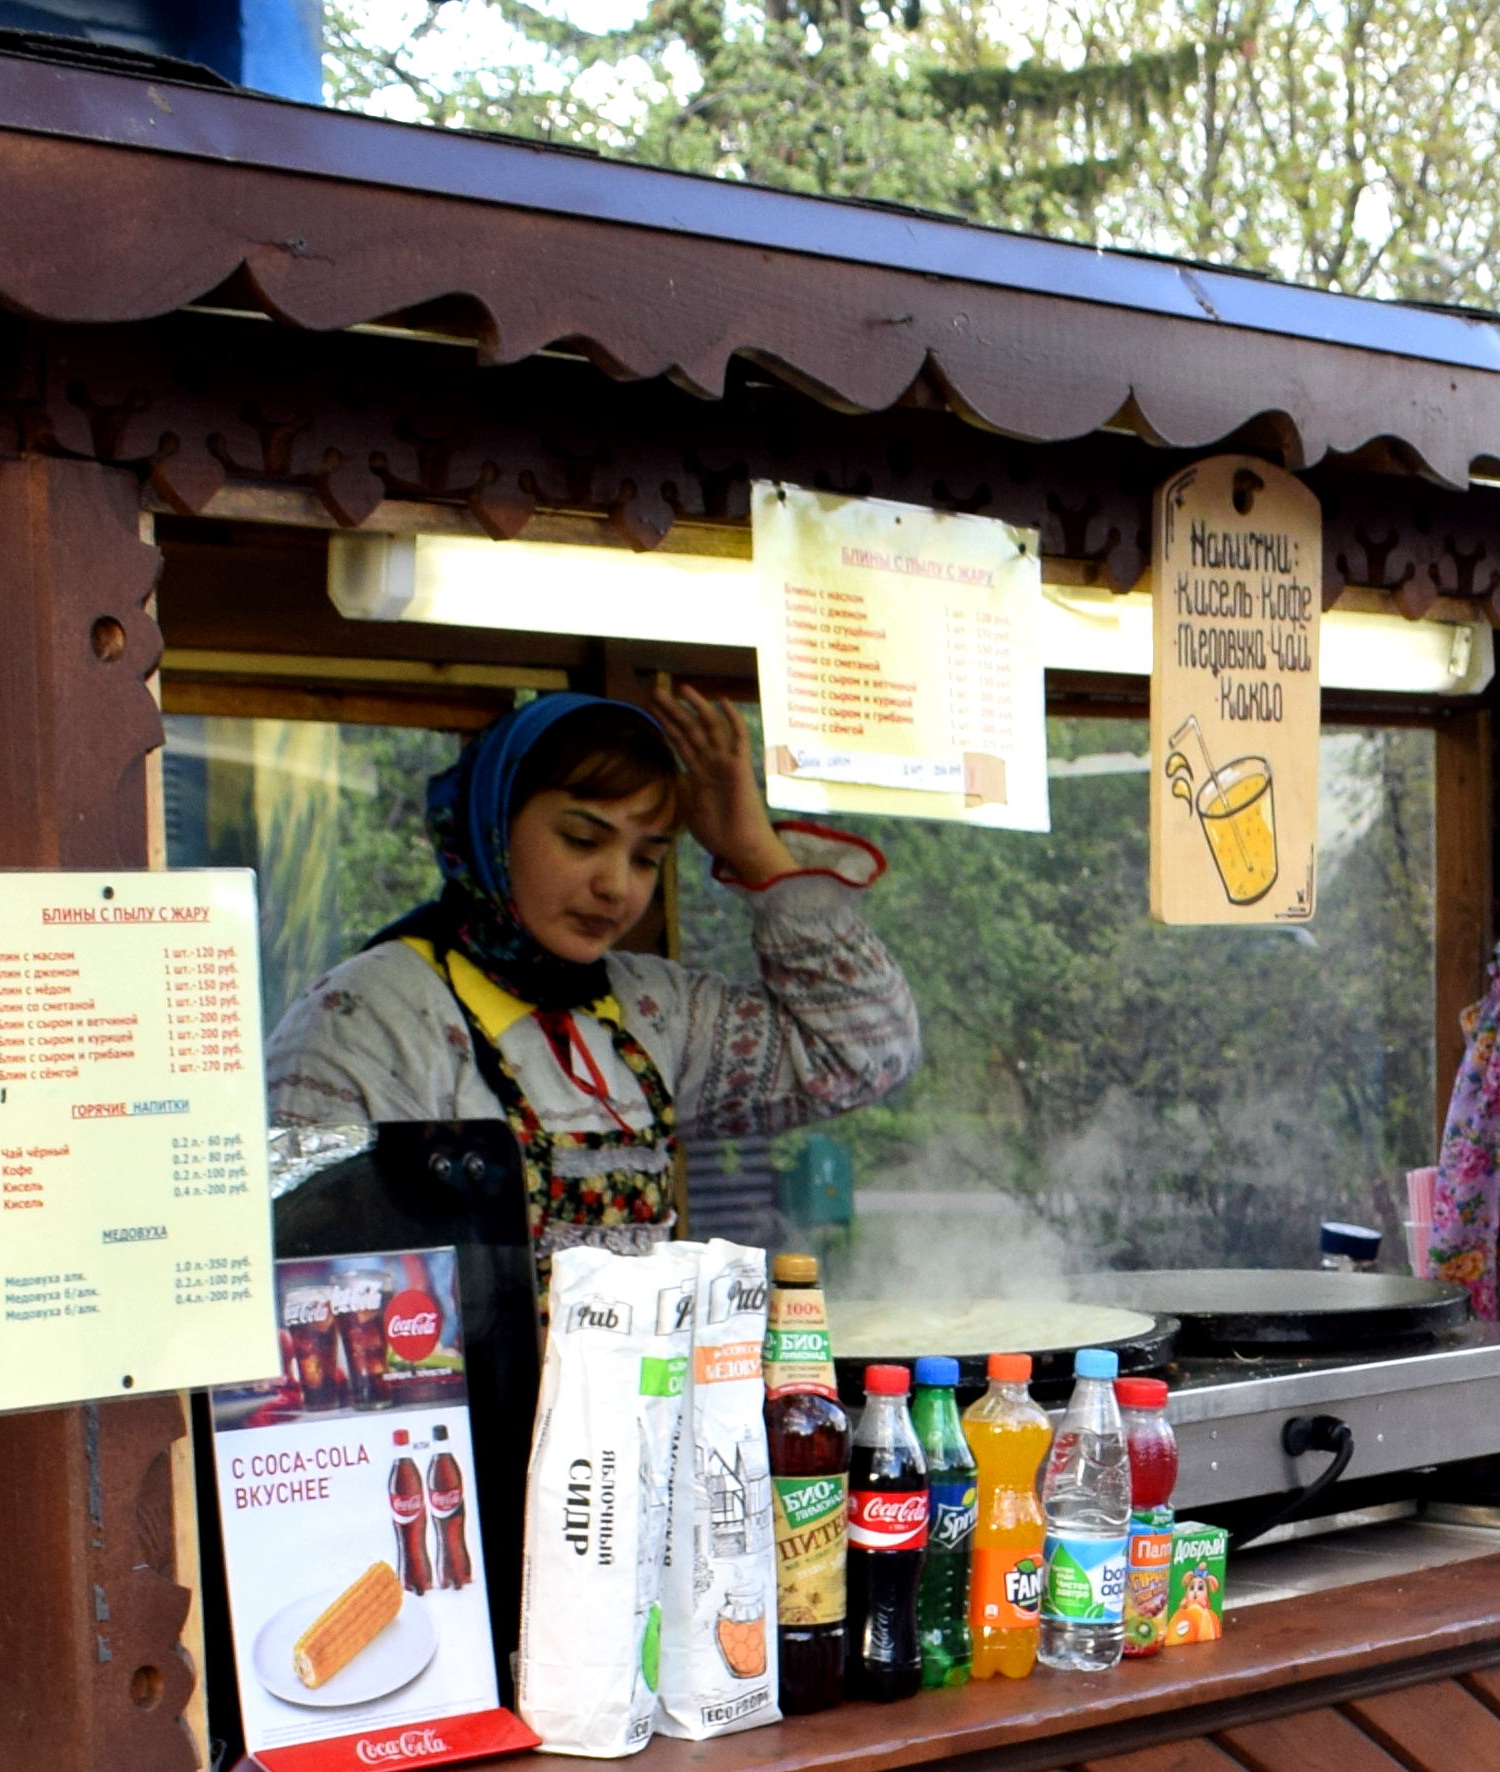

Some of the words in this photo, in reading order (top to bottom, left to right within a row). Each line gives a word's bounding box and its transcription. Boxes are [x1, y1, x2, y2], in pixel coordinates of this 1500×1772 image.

[1177, 571, 1252, 619] Кисель
[1261, 574, 1312, 632] Кофе
[1271, 622, 1311, 671] Чай
[1221, 675, 1283, 722] Какао
[42, 907, 95, 924] БЛИНЫ
[100, 907, 109, 922] С
[114, 906, 153, 923] ПЫЛУ
[159, 906, 167, 921] С
[170, 906, 210, 922] ЖАРУ
[23, 953, 29, 961] с
[33, 952, 75, 961] маслом
[164, 948, 168, 958] 1
[24, 970, 30, 978] с
[34, 969, 80, 979] джемом
[165, 964, 169, 975] 1
[26, 987, 31, 995] с
[35, 984, 71, 996] мёдом
[166, 981, 171, 991] 1
[27, 1003, 39, 1012] со
[43, 999, 95, 1011] сметаной
[167, 997, 171, 1008] 1
[28, 1021, 34, 1029] с
[37, 1020, 73, 1032] сыром
[87, 1014, 138, 1026] ветчиной
[168, 1014, 173, 1024] 1
[29, 1038, 34, 1046] с
[37, 1037, 74, 1047] сыром
[88, 1031, 133, 1045] курицей
[169, 1030, 173, 1040] 1
[39, 1054, 75, 1064] сыром
[89, 1048, 135, 1064] грибами
[170, 1046, 174, 1056] 1
[31, 1071, 36, 1080] с
[40, 1066, 78, 1079] сёмгой
[171, 1063, 175, 1073] 1
[72, 1103, 126, 1119] ГОРЯЧИЕ
[133, 1100, 190, 1115] НАПИТКИ
[1, 1146, 23, 1159] Чай
[2, 1166, 33, 1177] Кофе
[3, 1182, 44, 1193] Кисель
[4, 1200, 44, 1210] Кисель
[102, 1225, 168, 1243] МЕДОВУХА
[5, 1275, 60, 1288] Медовуха
[5, 1291, 61, 1305] Медовуха
[6, 1307, 61, 1321] Медовуха
[578, 1306, 619, 1329] Pub
[388, 1312, 438, 1338] Coca-Cola
[232, 1458, 244, 1479] С
[252, 1444, 370, 1477] COCA-COLA
[236, 1477, 330, 1509] ВКУСНЕЕ
[563, 1459, 592, 1556] СИДР
[599, 1450, 615, 1566] ЯБЛОЧНЫЙ
[863, 1497, 927, 1522] Coca-Cola
[1174, 1532, 1226, 1565] ДОБРЫЙ
[1006, 1566, 1044, 1602] FAN
[356, 1728, 448, 1765] Coca-Cola
